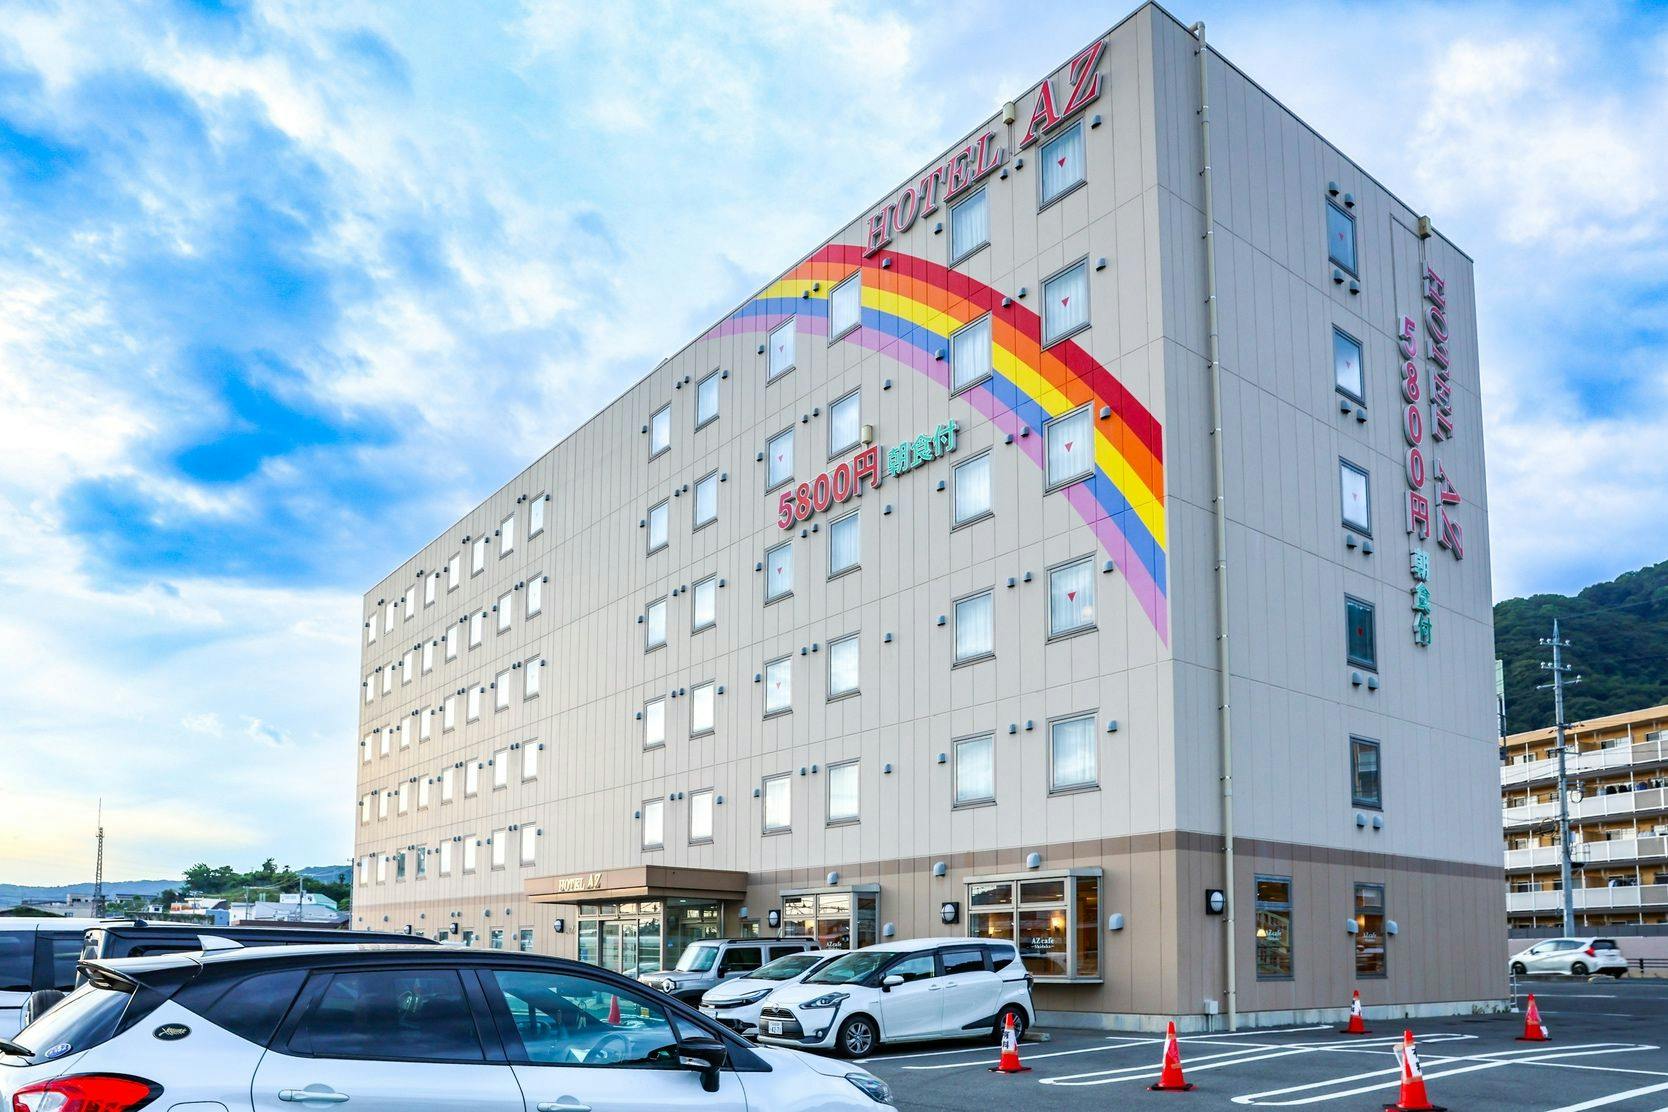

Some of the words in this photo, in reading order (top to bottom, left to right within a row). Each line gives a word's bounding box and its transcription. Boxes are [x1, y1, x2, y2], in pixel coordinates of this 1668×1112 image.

[862, 130, 1007, 259] HOTEL
[1019, 39, 1108, 150] AZ
[1423, 266, 1453, 441] HOTEL
[777, 444, 882, 530] 5800円
[1434, 458, 1463, 561] AZ
[558, 877, 585, 891] HOTEL
[587, 872, 603, 889] AZ
